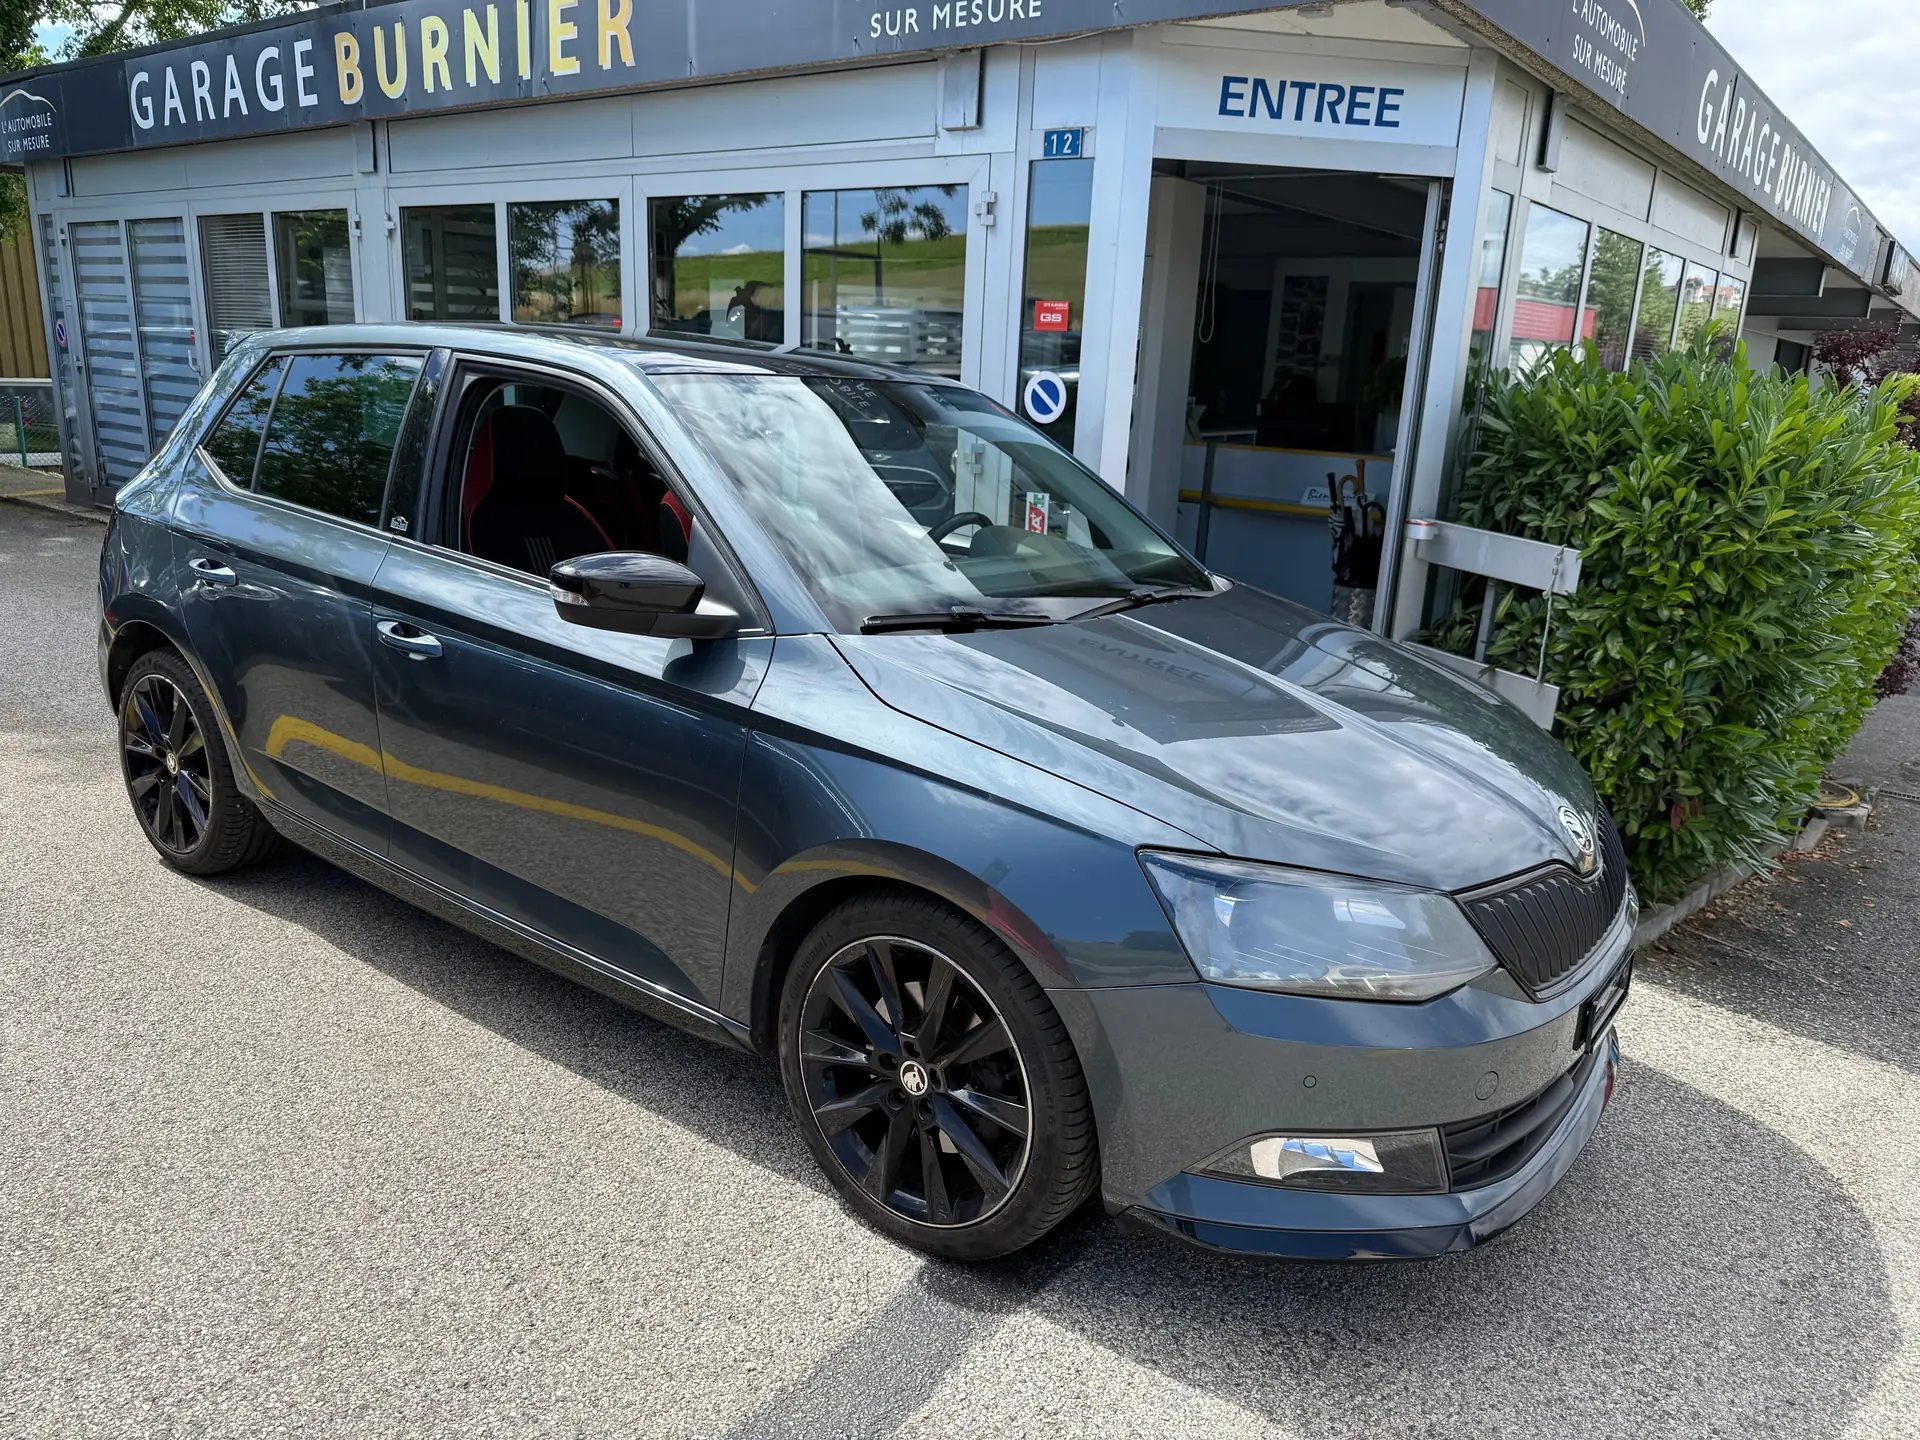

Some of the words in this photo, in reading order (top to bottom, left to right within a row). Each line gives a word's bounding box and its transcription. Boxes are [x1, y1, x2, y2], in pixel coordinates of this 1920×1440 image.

[871, 8, 919, 38] SUR
[933, 0, 1042, 30] MESURE
[130, 39, 318, 129] GARAGE
[334, 0, 636, 105] BURNIER
[1573, 34, 1592, 69] SUR
[1594, 50, 1627, 94] MESURE
[1218, 75, 1404, 128] ENTREE
[2, 112, 52, 133] L'AUTOMOBILE
[8, 139, 21, 153] SUR
[23, 134, 50, 151] MESURE
[1049, 133, 1075, 155] 12
[1697, 69, 1780, 194] GARAGE
[1774, 143, 1831, 236] BURNIER
[1040, 313, 1062, 322] GS
